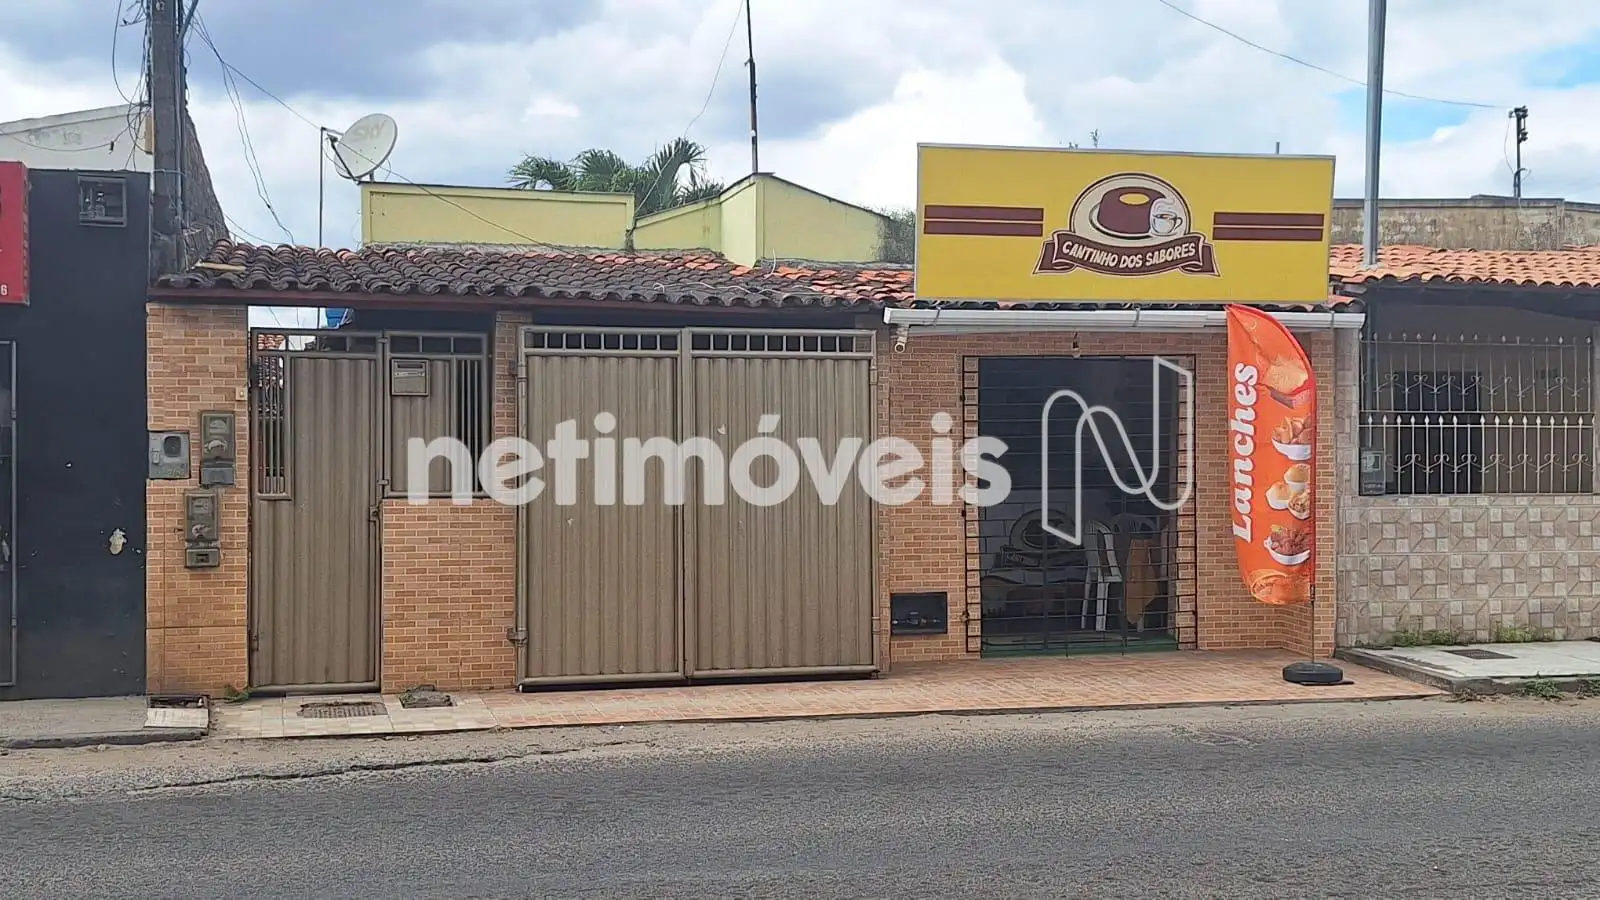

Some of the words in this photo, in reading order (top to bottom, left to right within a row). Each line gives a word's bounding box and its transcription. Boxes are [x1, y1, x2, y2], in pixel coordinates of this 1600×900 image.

[1062, 241, 1118, 267] CANTINHO
[1119, 255, 1143, 268] DOS
[1146, 243, 1196, 266] SABORES
[1231, 362, 1258, 543] Lanches
